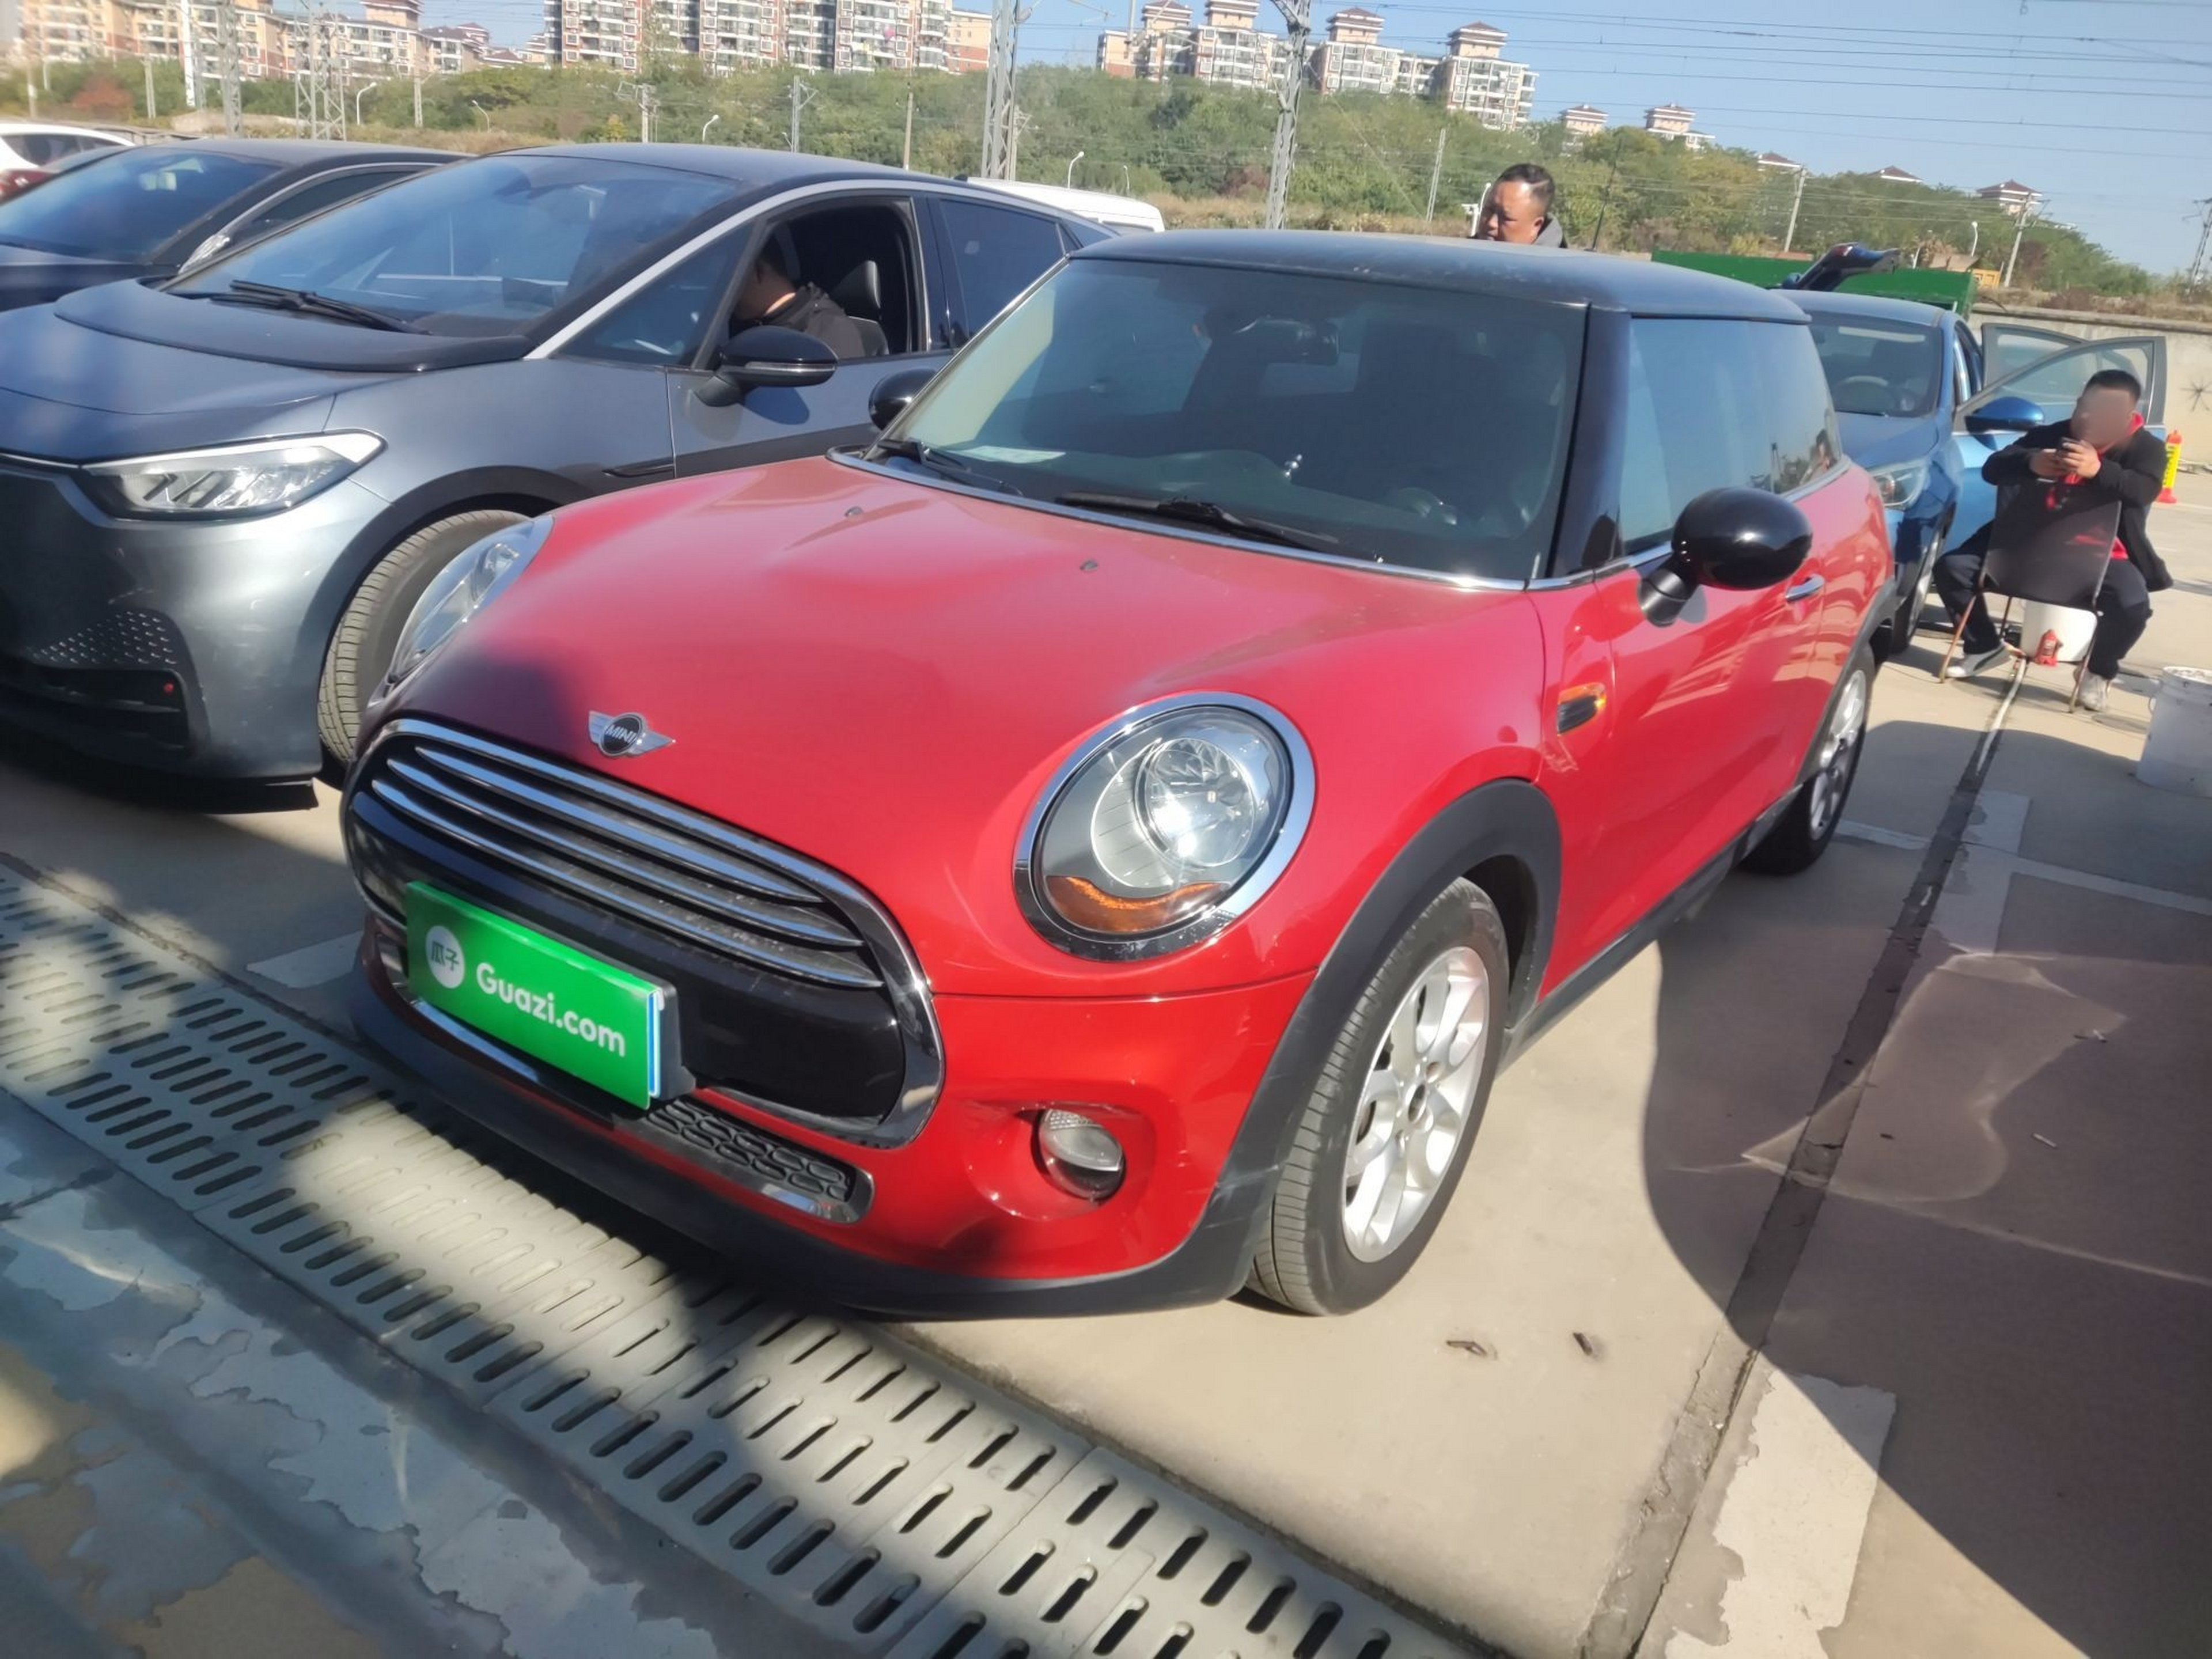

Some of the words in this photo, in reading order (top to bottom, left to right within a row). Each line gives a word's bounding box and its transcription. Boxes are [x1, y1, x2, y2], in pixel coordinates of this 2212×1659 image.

[605, 725, 637, 744] MINI
[431, 941, 460, 972] 瓜子
[476, 962, 625, 1057] Guazi.com
